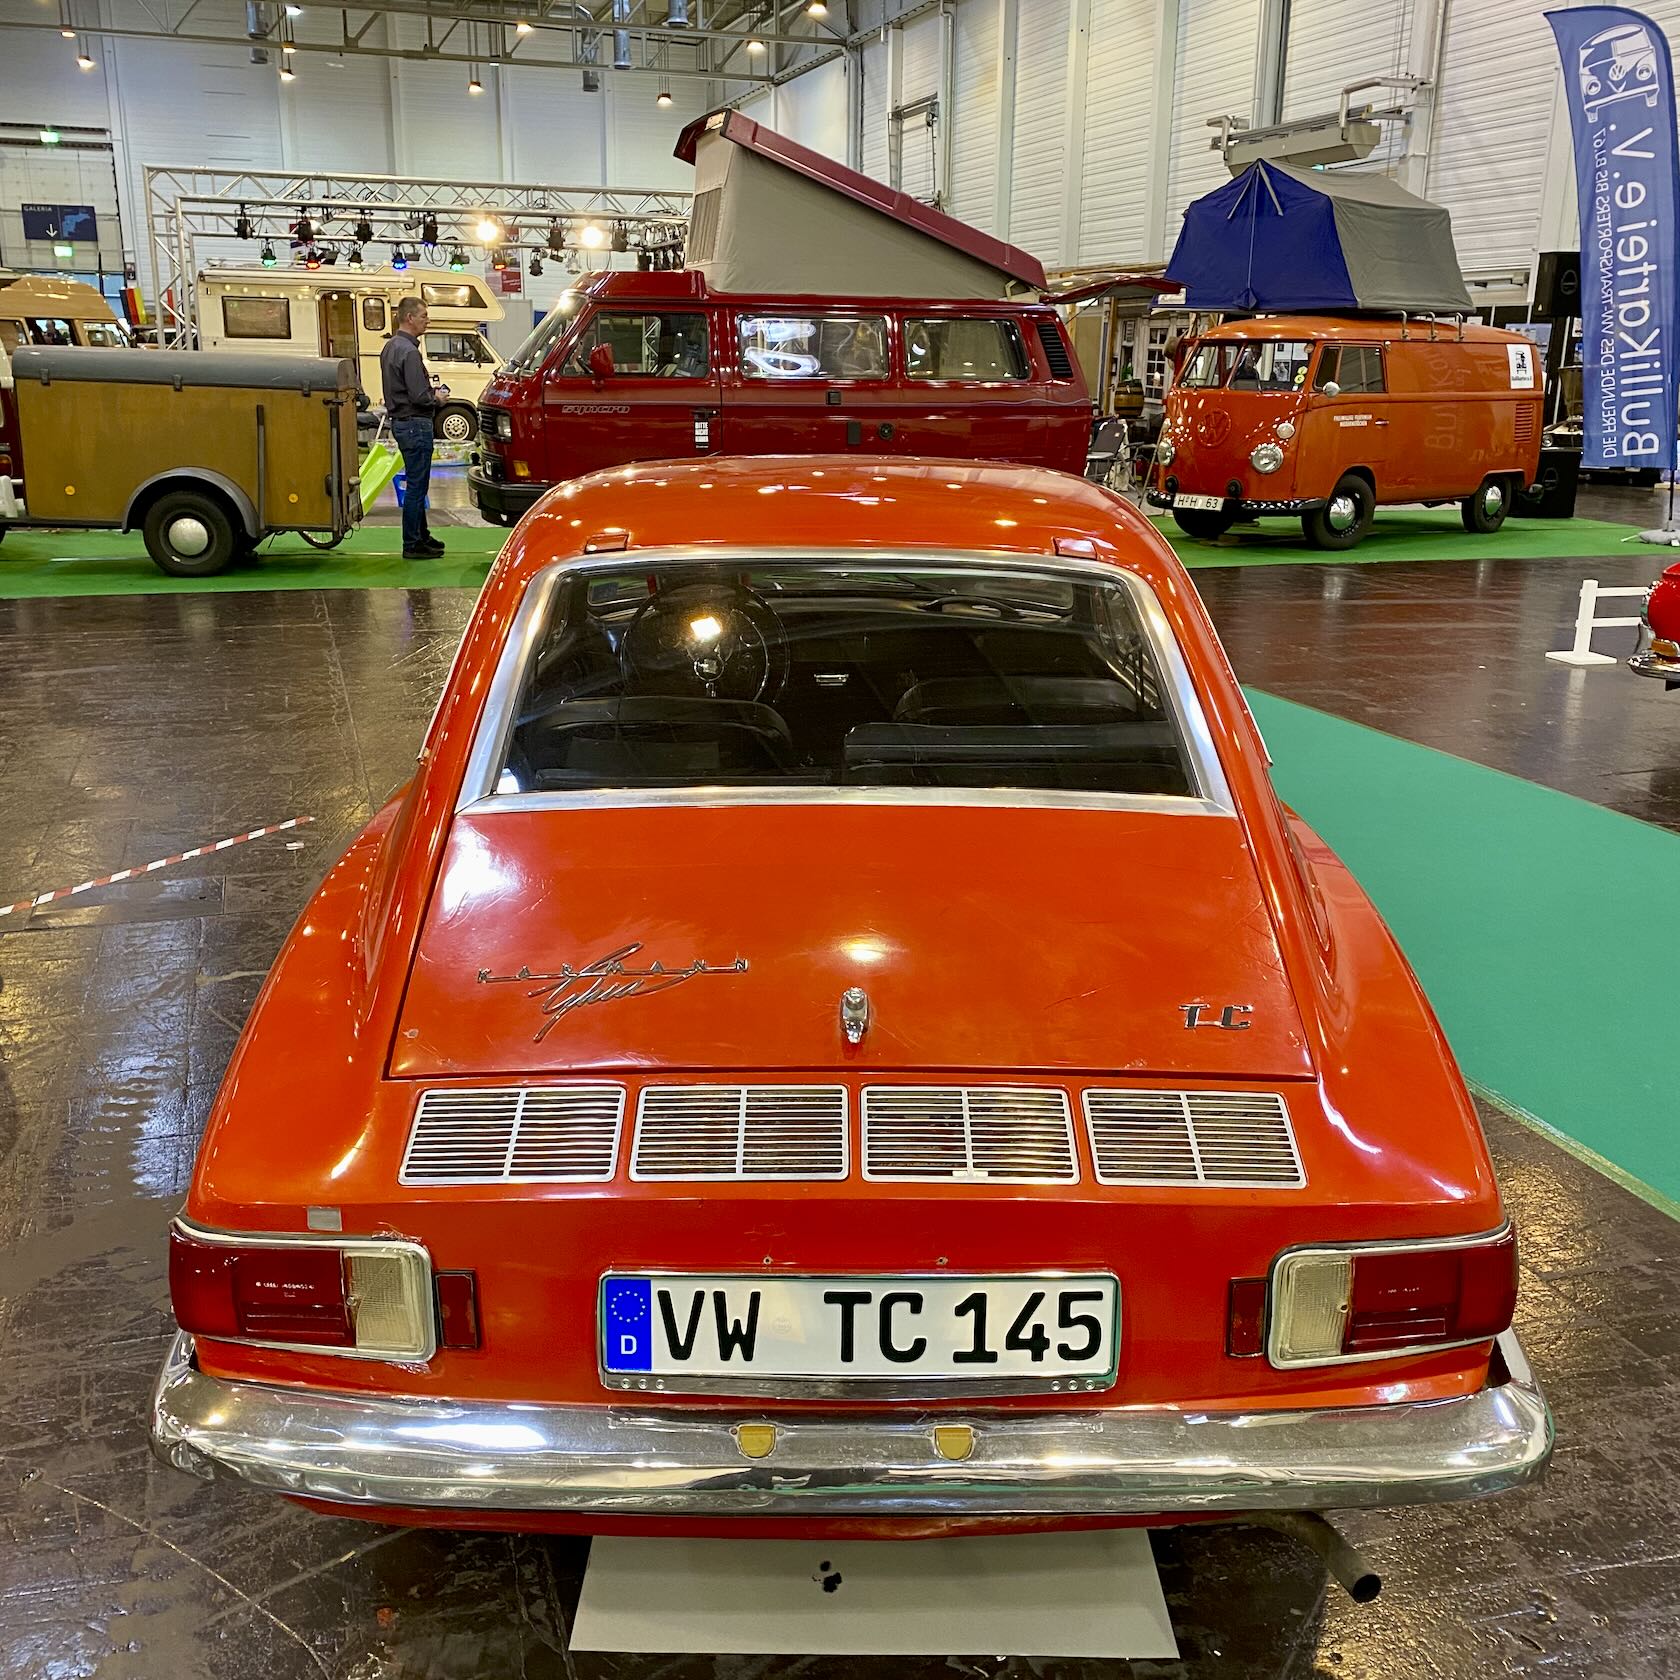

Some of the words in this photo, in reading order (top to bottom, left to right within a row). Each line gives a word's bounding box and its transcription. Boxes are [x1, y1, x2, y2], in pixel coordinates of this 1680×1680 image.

[561, 405, 630, 415] syncro
[1205, 498, 1219, 509] 63
[477, 957, 750, 983] KARMANN
[1178, 1003, 1255, 1030] TC
[656, 1289, 761, 1363] VW
[823, 1290, 927, 1364] TC
[951, 1289, 1104, 1364] 145
[620, 1336, 637, 1355] D
